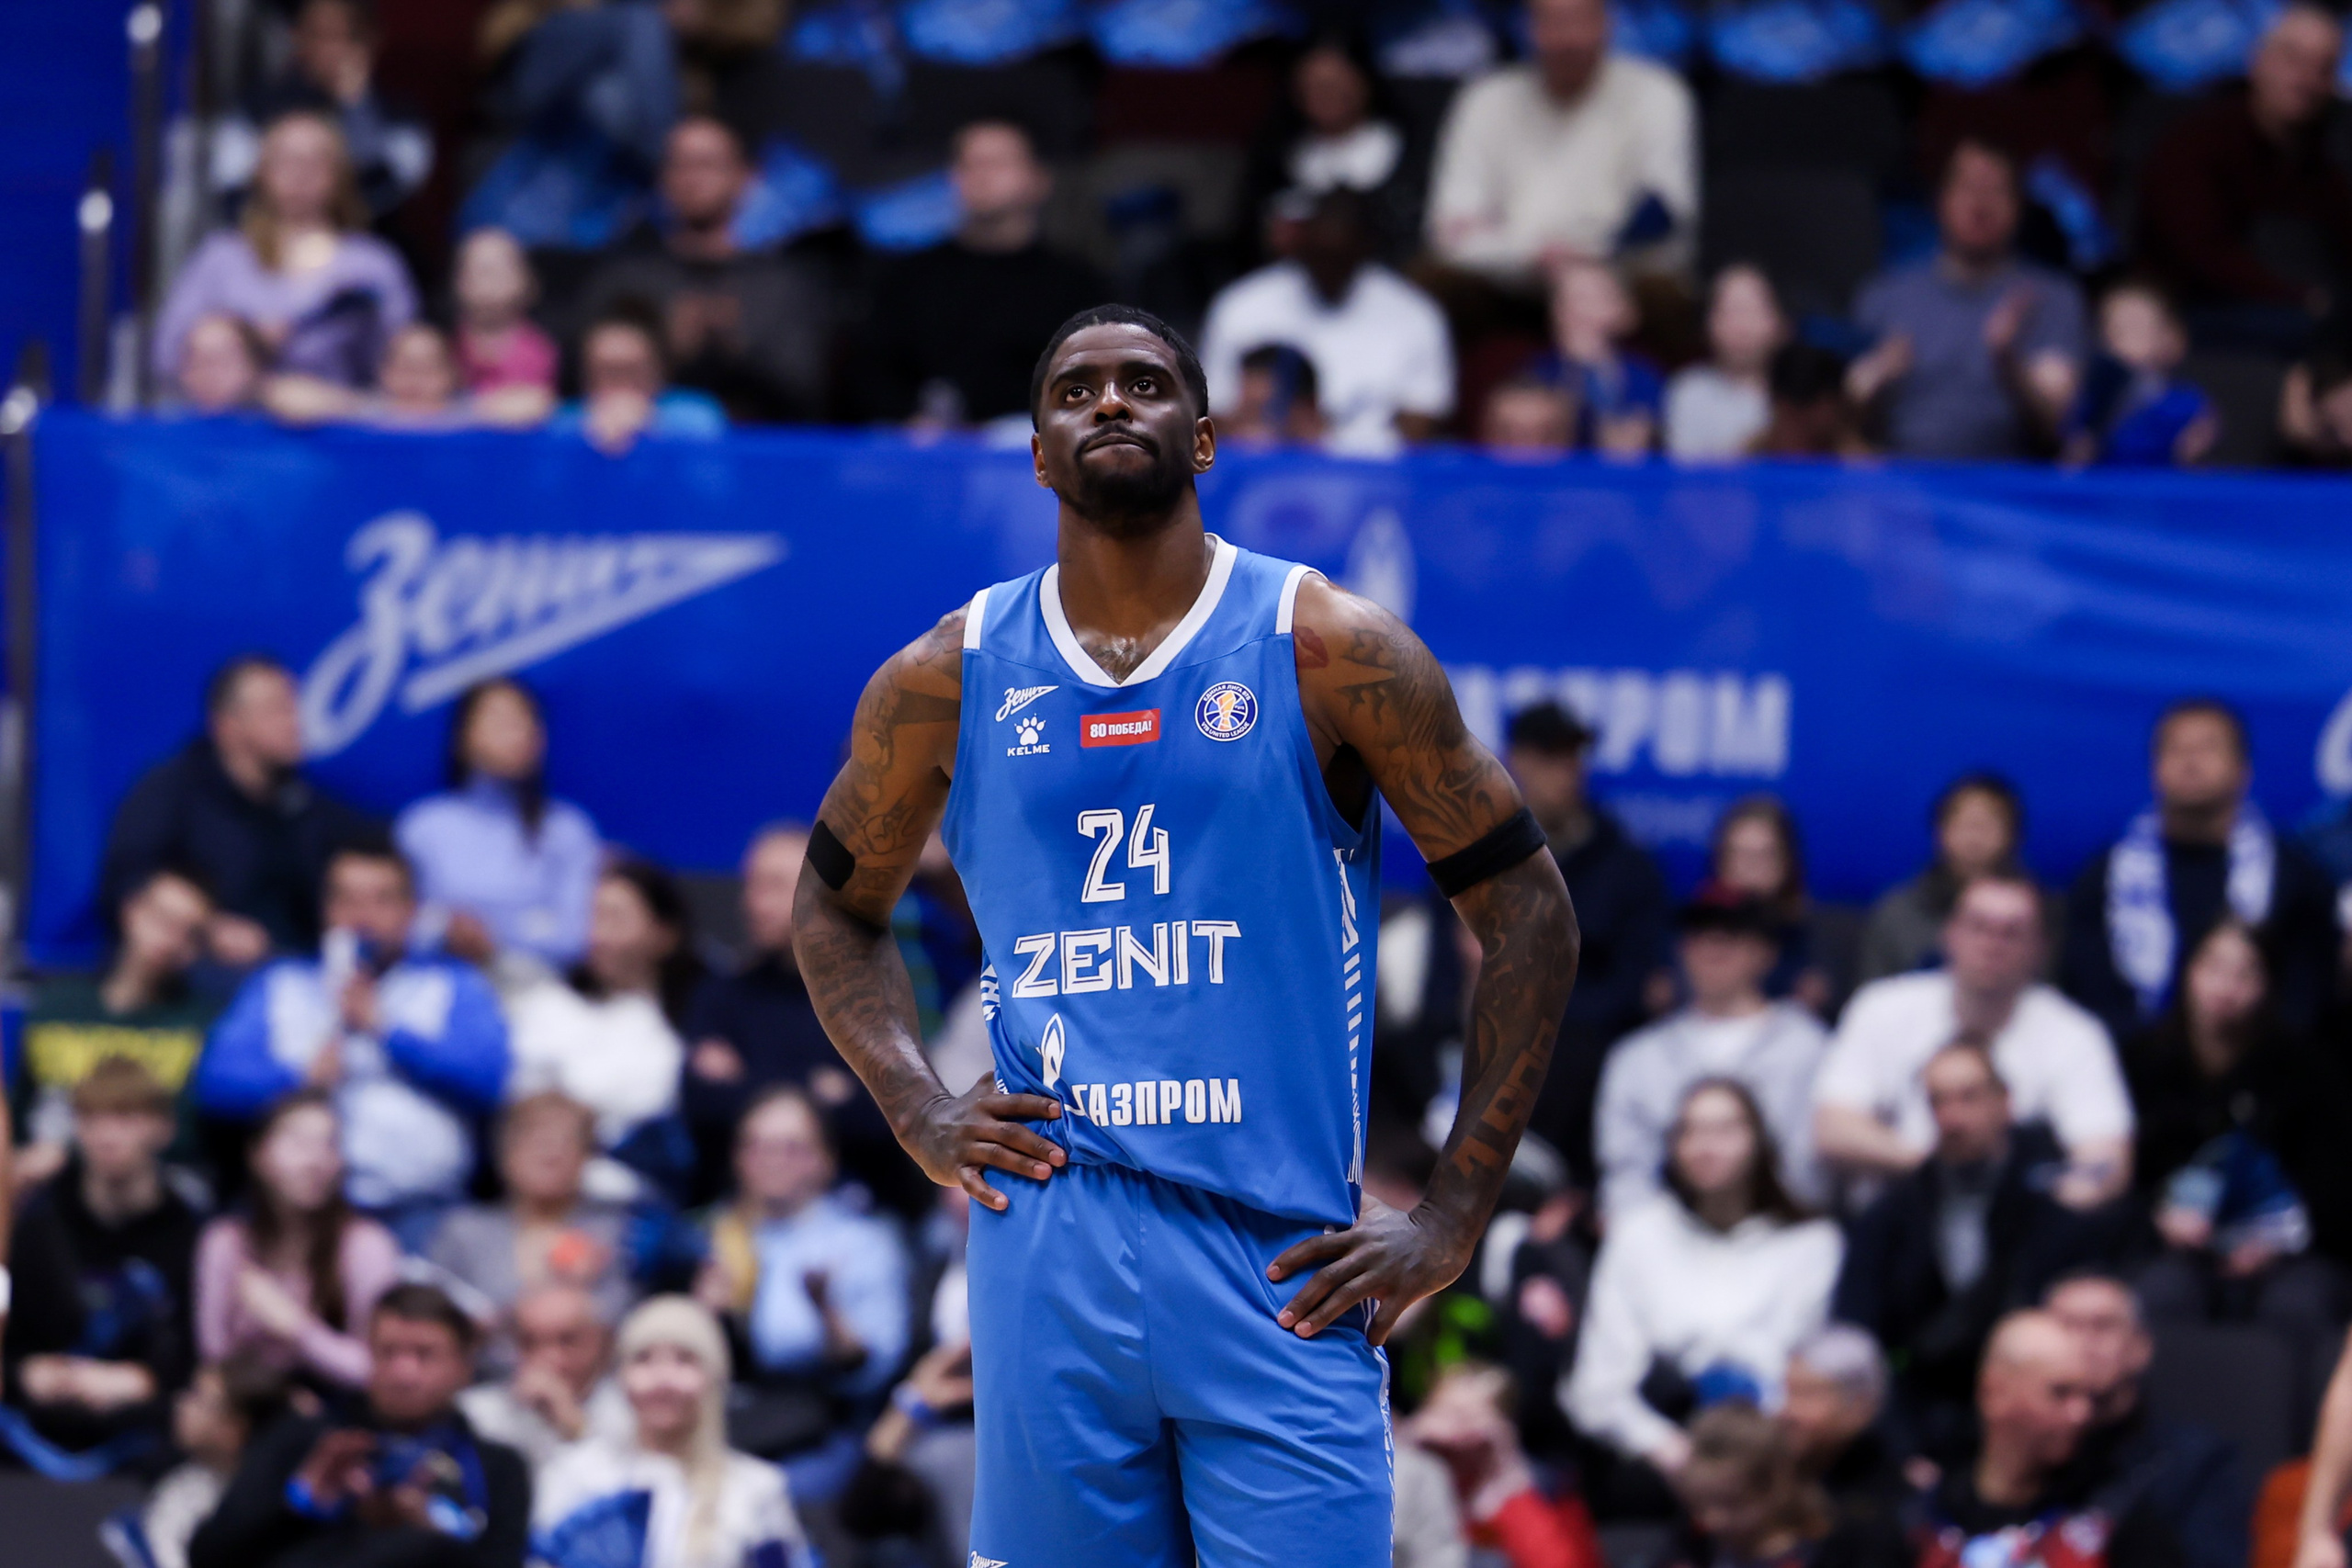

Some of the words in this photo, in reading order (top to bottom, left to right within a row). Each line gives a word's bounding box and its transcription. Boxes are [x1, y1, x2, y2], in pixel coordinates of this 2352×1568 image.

[1227, 684, 1243, 694] ЛИГА
[995, 685, 1059, 722] Зенит
[1090, 723, 1107, 739] 80
[1108, 719, 1152, 736] ПОБЕДА!
[1201, 721, 1210, 732] VTB
[1209, 729, 1230, 739] UNITED
[1230, 721, 1250, 737] LEAGUE
[1007, 744, 1050, 757] KELME
[1077, 803, 1170, 903] 24
[1012, 919, 1242, 998] ZENIT
